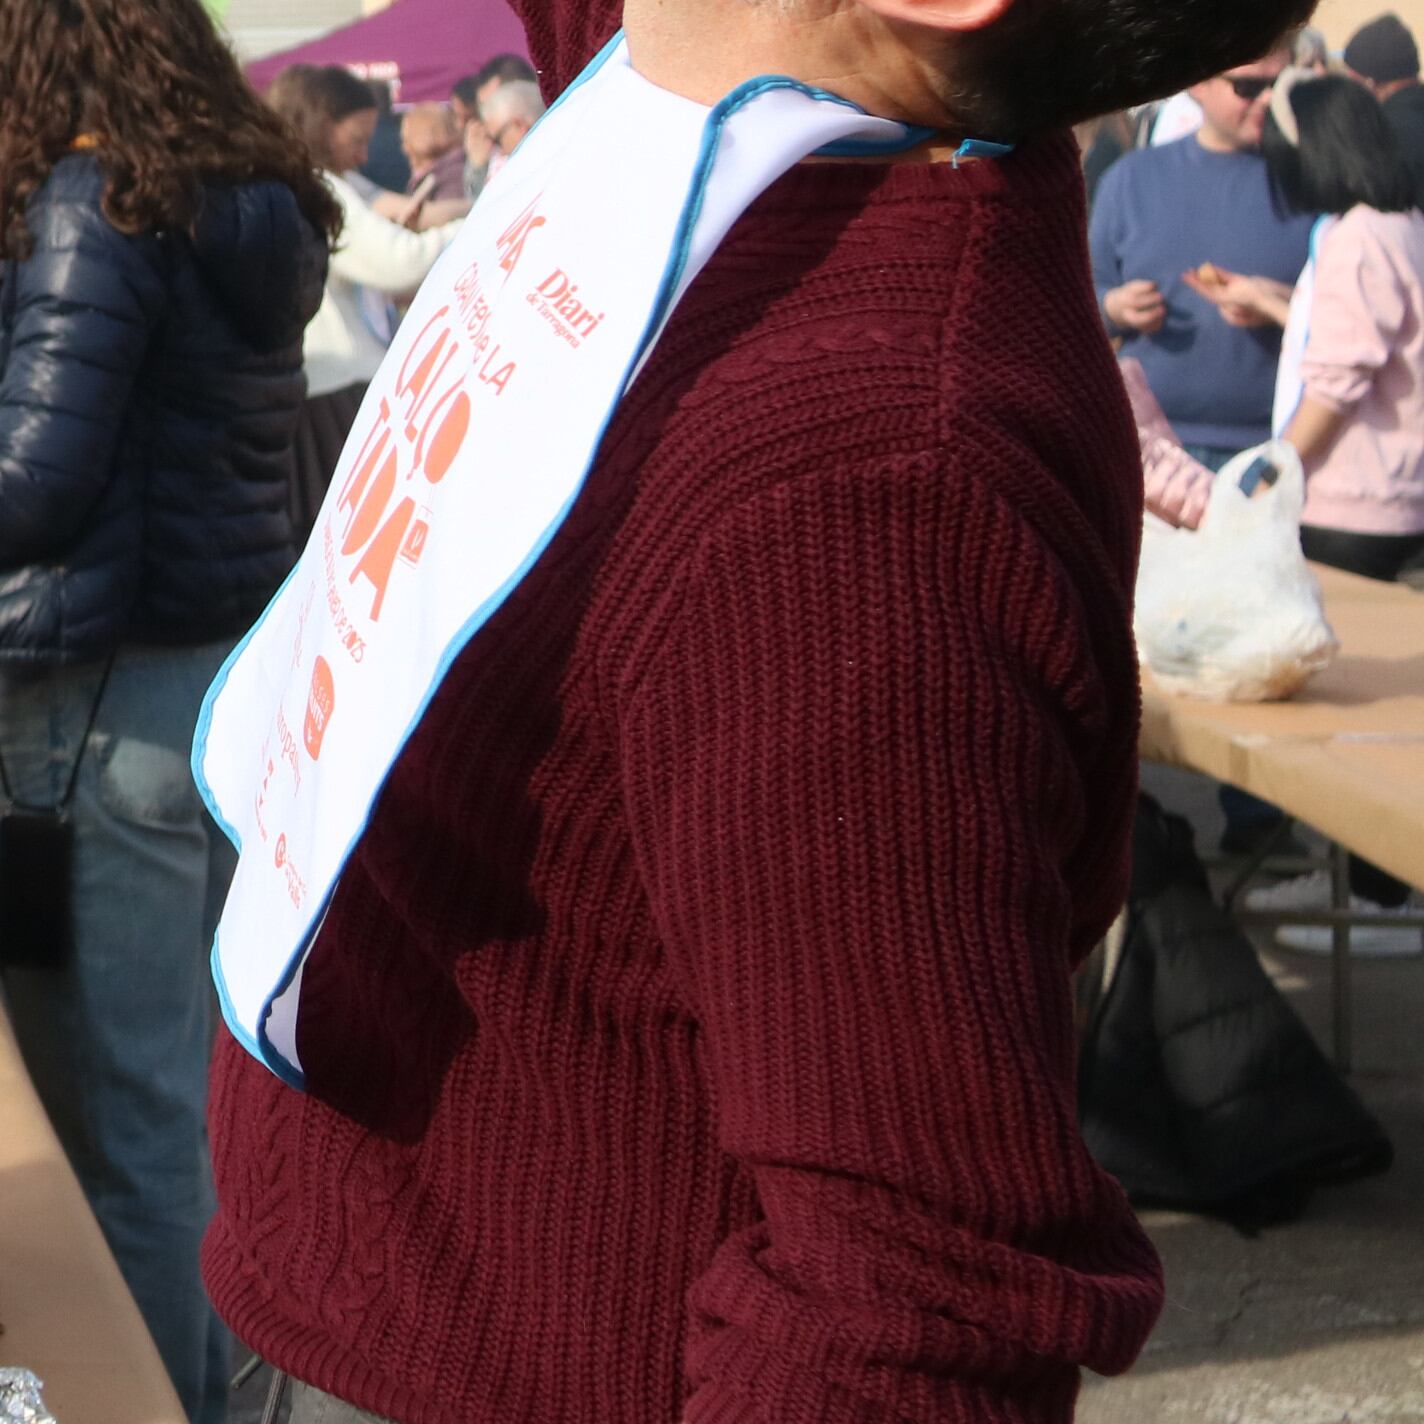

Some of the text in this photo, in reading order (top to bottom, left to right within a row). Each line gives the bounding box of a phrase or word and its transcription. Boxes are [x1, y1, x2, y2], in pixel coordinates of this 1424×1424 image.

[535, 267, 605, 340] Diari
[536, 301, 582, 350] Tarragona
[478, 344, 517, 397] LA
[337, 395, 416, 623] TADA
